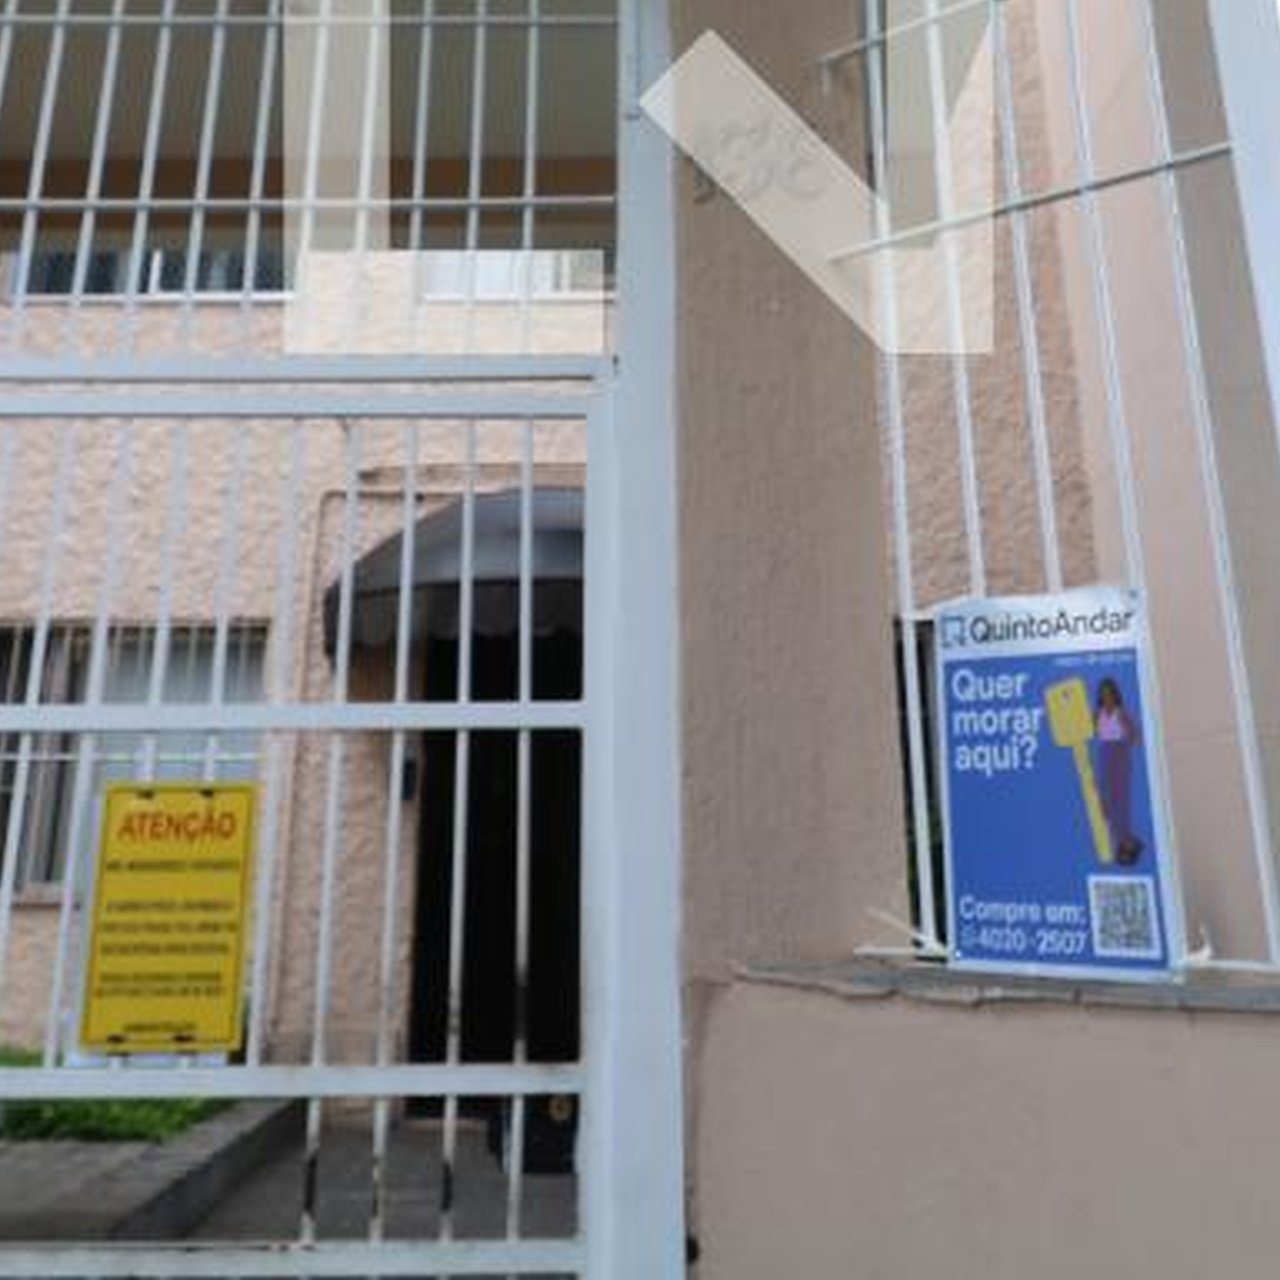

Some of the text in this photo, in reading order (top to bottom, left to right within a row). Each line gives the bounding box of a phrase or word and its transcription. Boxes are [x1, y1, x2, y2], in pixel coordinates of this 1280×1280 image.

[970, 608, 1134, 644] QuintoAndar
[951, 669, 1029, 702] Quer
[952, 707, 1044, 737] morar
[954, 734, 1039, 780] aqui?
[117, 809, 237, 844] ATENÇÃO
[959, 894, 1043, 927] Compre
